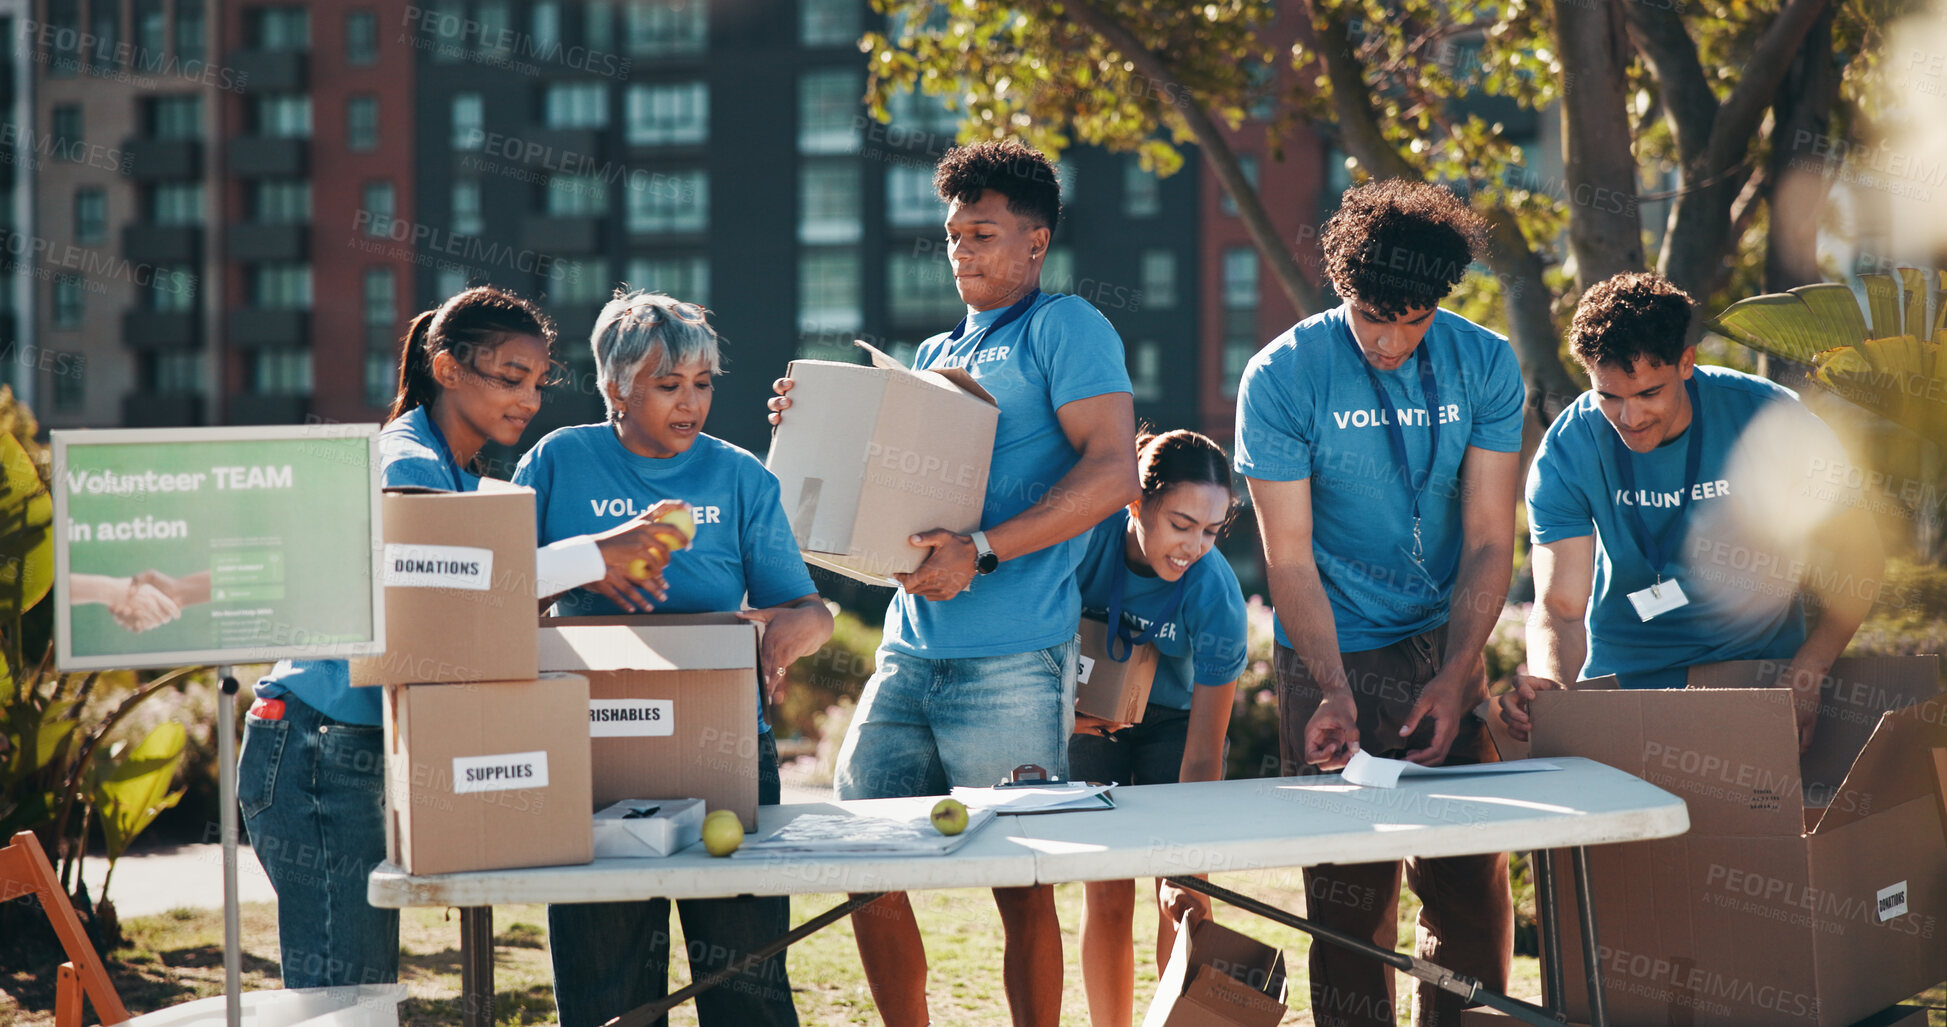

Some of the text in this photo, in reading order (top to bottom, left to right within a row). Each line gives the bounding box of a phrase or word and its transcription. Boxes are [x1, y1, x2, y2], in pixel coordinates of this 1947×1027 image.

[67, 469, 206, 494] Volunteer
[212, 465, 293, 490] TEAM
[68, 514, 188, 541] in action
[395, 559, 480, 576] DONATIONS
[466, 763, 533, 782] SUPPLIES
[1879, 890, 1905, 913] DONATIONS
